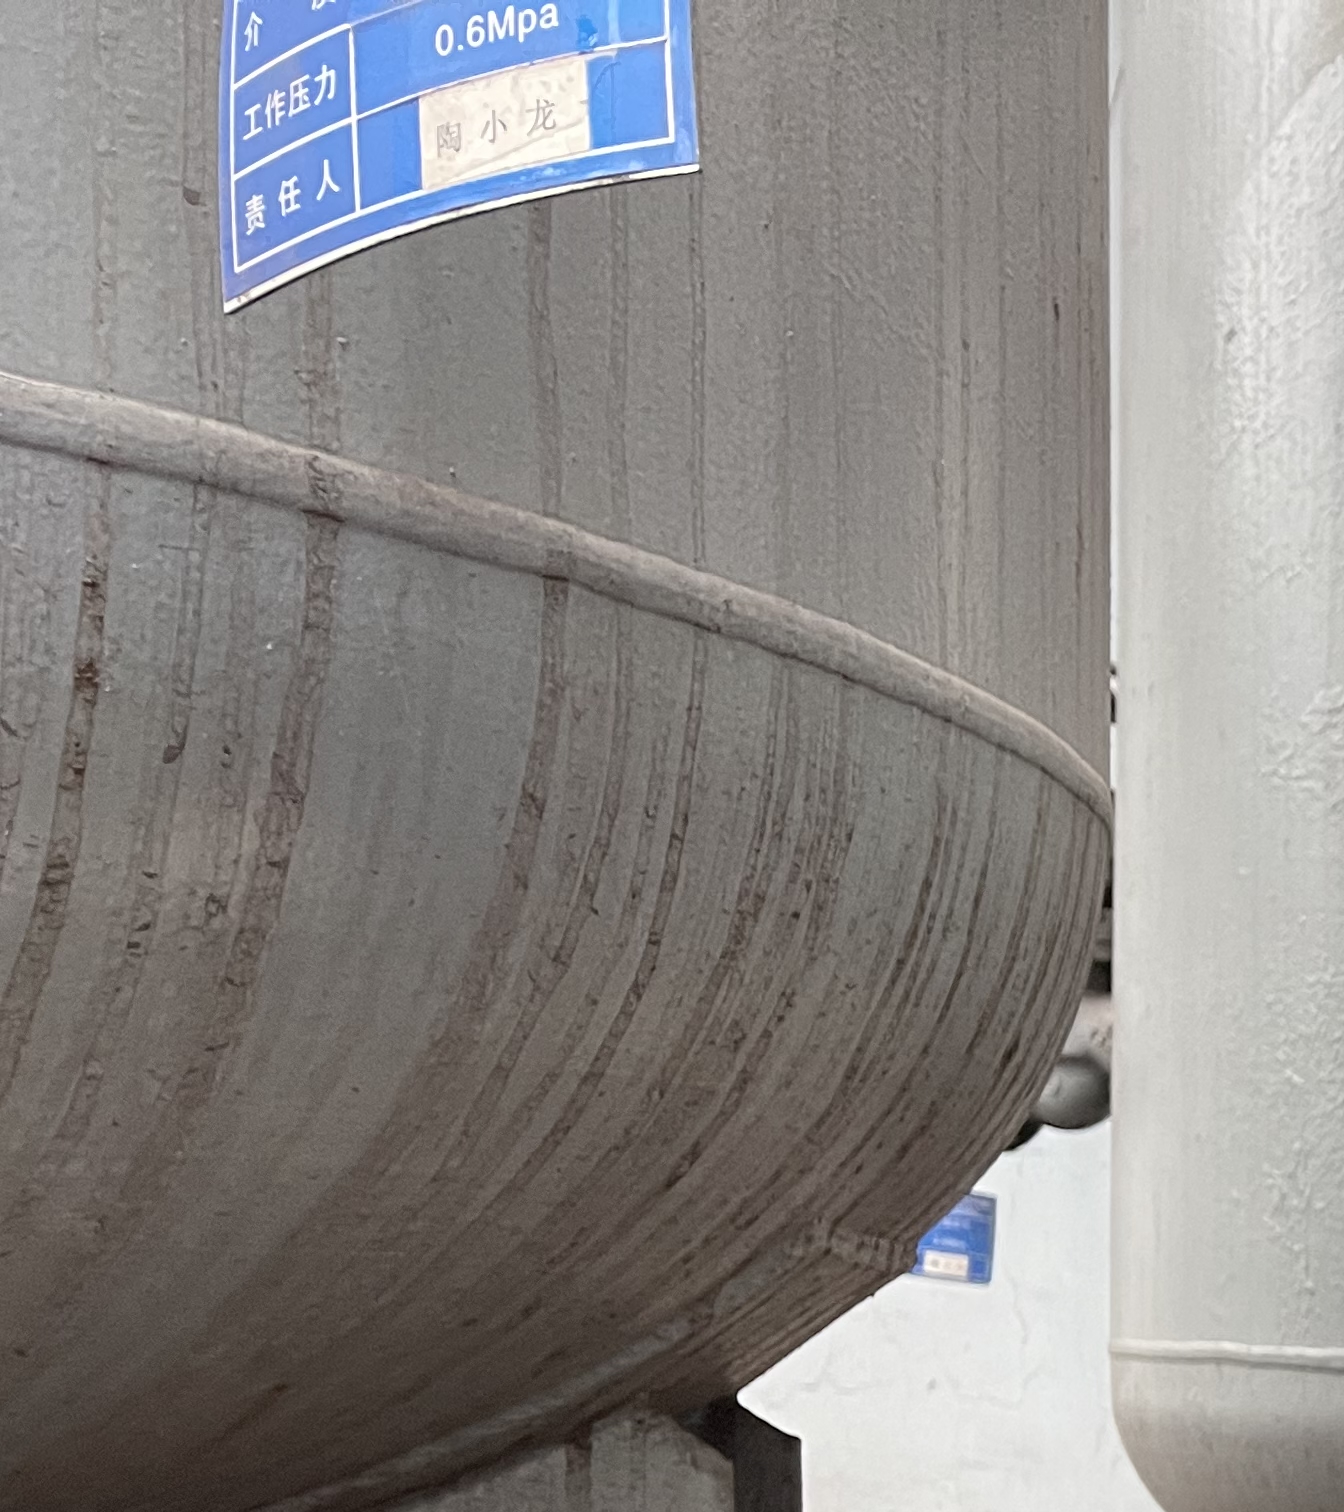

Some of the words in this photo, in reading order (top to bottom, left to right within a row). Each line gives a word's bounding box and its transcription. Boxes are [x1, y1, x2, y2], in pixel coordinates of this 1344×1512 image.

[434, 3, 559, 57] 0.6Mpa
[242, 65, 336, 140] 工作压力
[244, 159, 341, 237] 责任人
